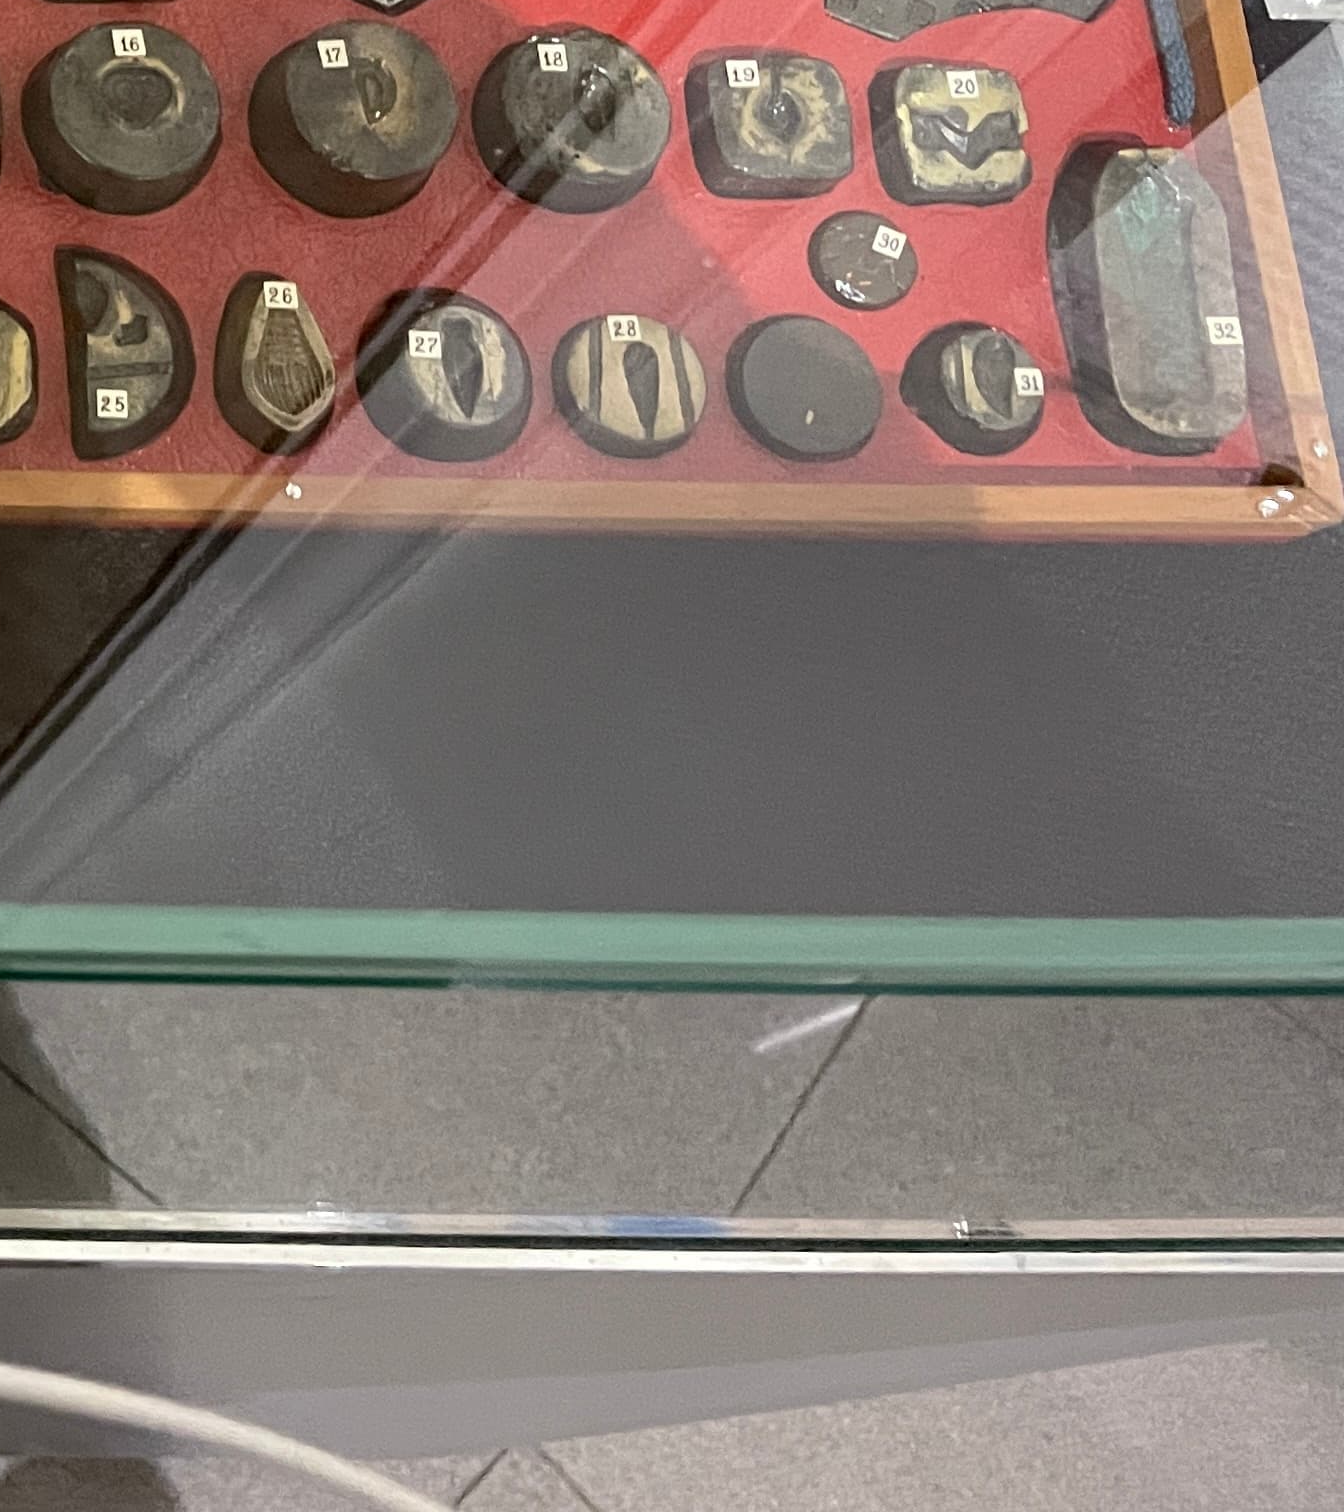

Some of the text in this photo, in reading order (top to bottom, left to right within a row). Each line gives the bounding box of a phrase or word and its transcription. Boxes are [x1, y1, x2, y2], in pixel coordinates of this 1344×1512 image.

[121, 36, 140, 52] 16
[325, 47, 341, 64] 17
[543, 51, 564, 67] 18
[732, 67, 755, 83] 19
[954, 78, 975, 95] 20
[878, 233, 900, 252] 30
[268, 287, 293, 305] 26
[613, 319, 637, 337] 28
[1214, 323, 1236, 339] 32
[414, 336, 438, 353] 27
[1021, 374, 1040, 392] 31
[100, 395, 125, 413] 25
